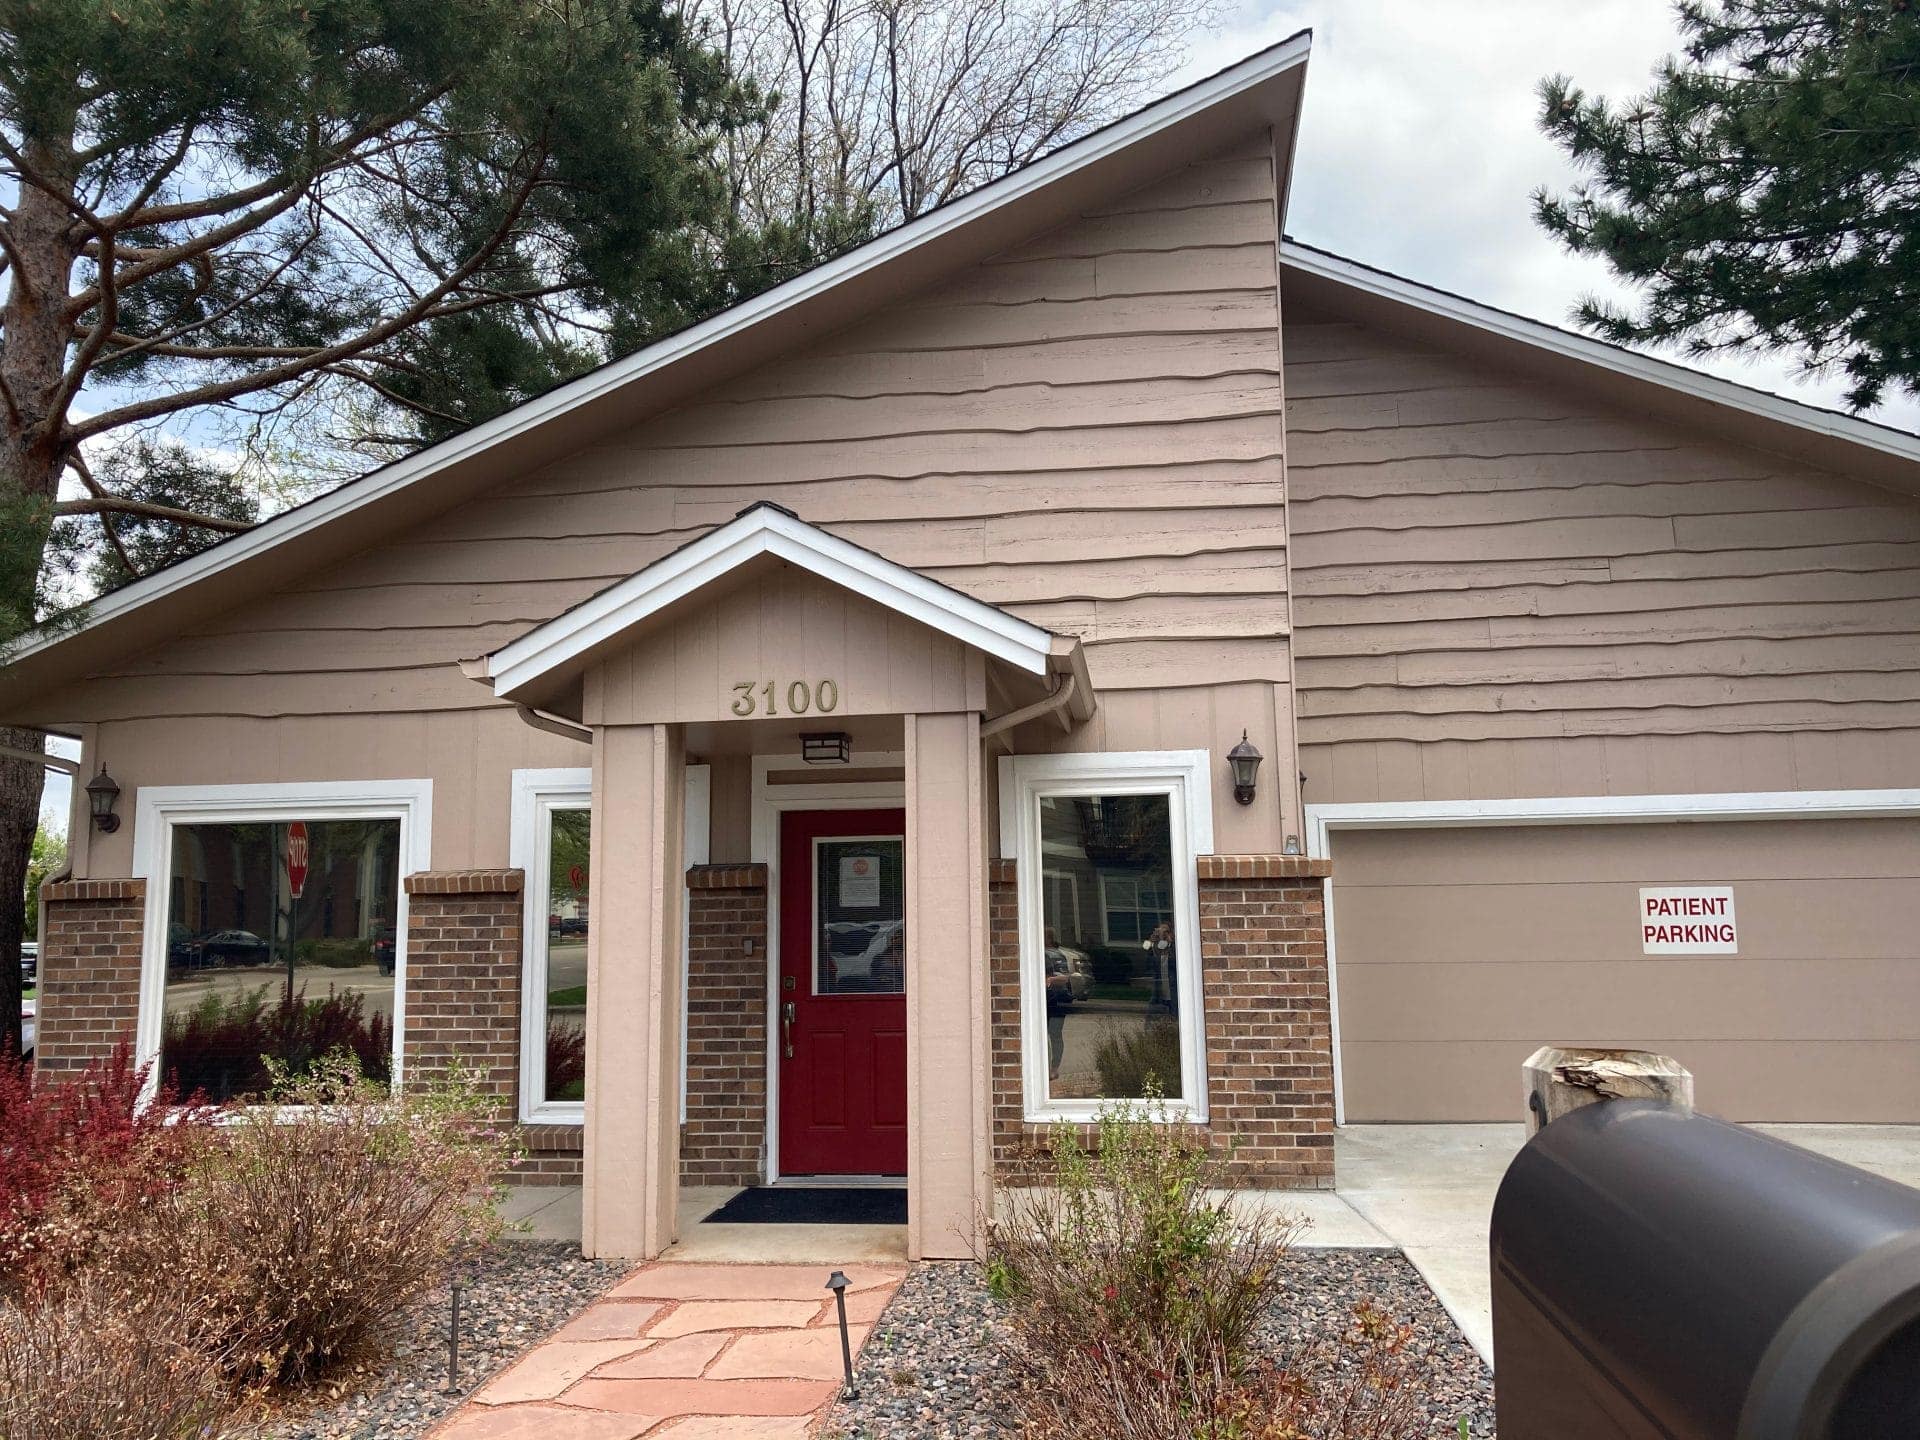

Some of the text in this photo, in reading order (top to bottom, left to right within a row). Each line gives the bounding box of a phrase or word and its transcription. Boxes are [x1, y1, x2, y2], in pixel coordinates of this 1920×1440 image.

[732, 680, 838, 716] 3100
[1646, 897, 1728, 916] PATIENT
[1644, 924, 1735, 943] PARKING
